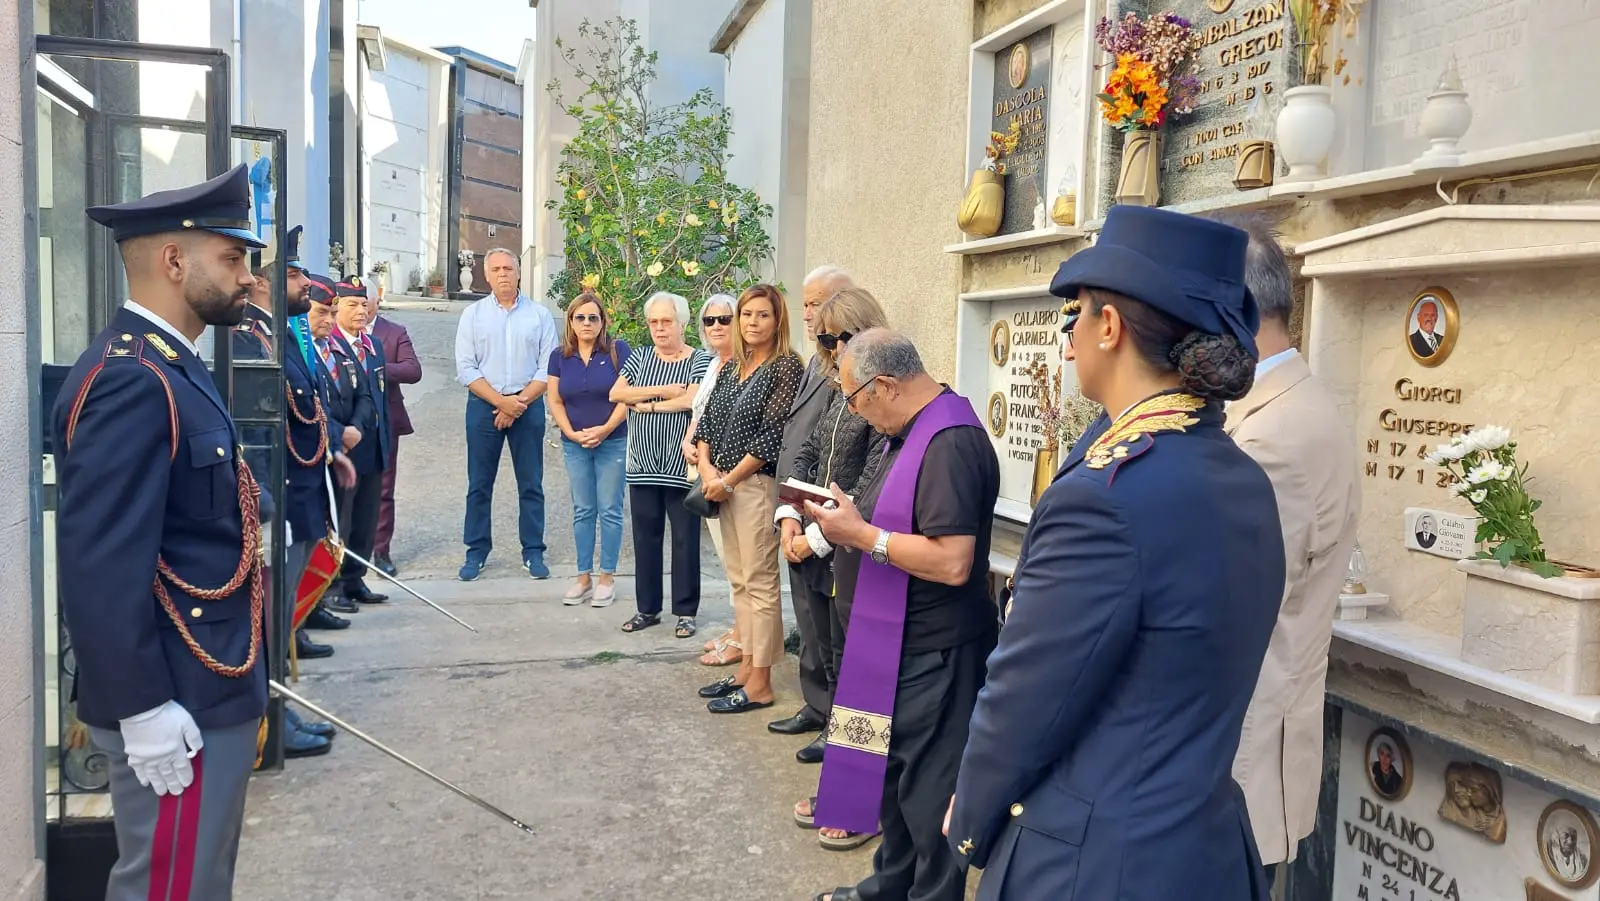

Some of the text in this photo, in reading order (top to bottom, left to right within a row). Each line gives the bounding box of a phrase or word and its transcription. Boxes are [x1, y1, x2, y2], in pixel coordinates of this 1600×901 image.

[1201, 61, 1271, 94] N 6 3 1917
[1264, 82, 1273, 94] 6
[996, 85, 1047, 117] DASCOLA
[1010, 106, 1042, 126] MARIA
[1195, 127, 1218, 145] TUOI
[1182, 151, 1204, 167] CON
[1012, 330, 1058, 346] CARMELA
[1012, 352, 1016, 361] N
[1025, 352, 1030, 361] 2
[1009, 421, 1013, 430] N
[1025, 423, 1029, 433] 7
[1023, 438, 1028, 447] 6
[1366, 438, 1379, 454] N
[1390, 442, 1407, 457] 17
[1012, 449, 1034, 462] VOSTRI
[1365, 461, 1378, 477] M
[1388, 465, 1405, 480] 17
[1417, 469, 1424, 484] 1
[1360, 796, 1434, 852] DIANO
[1343, 820, 1460, 901] VINCENZA
[1362, 861, 1372, 879] N
[1382, 874, 1399, 896] 24
[1358, 884, 1369, 901] M
